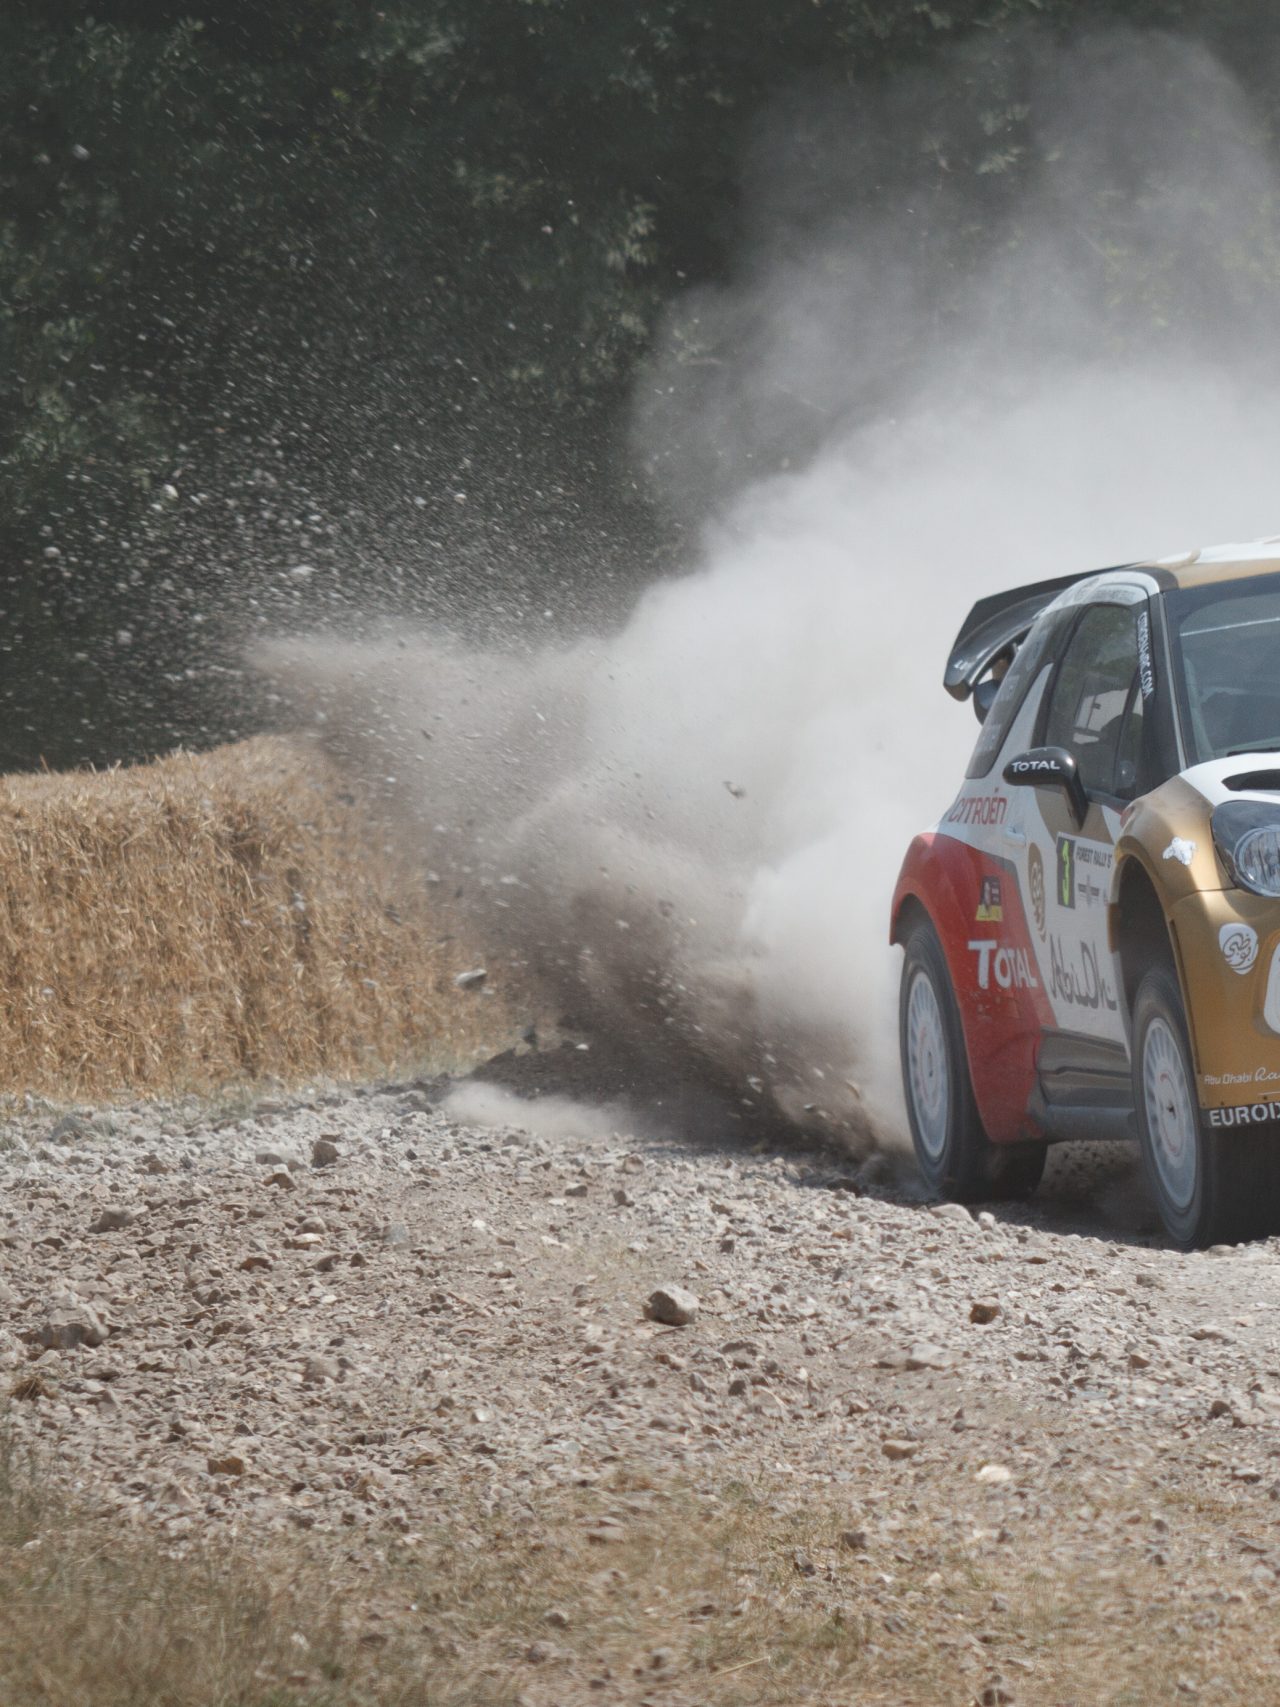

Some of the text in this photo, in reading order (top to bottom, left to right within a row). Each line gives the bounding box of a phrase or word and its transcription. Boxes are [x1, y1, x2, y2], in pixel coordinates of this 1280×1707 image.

[1012, 760, 1060, 773] TOTAL
[967, 939, 1038, 990] TOTAL
[1204, 1074, 1221, 1086] Abu
[1222, 1072, 1253, 1085] Dhabi
